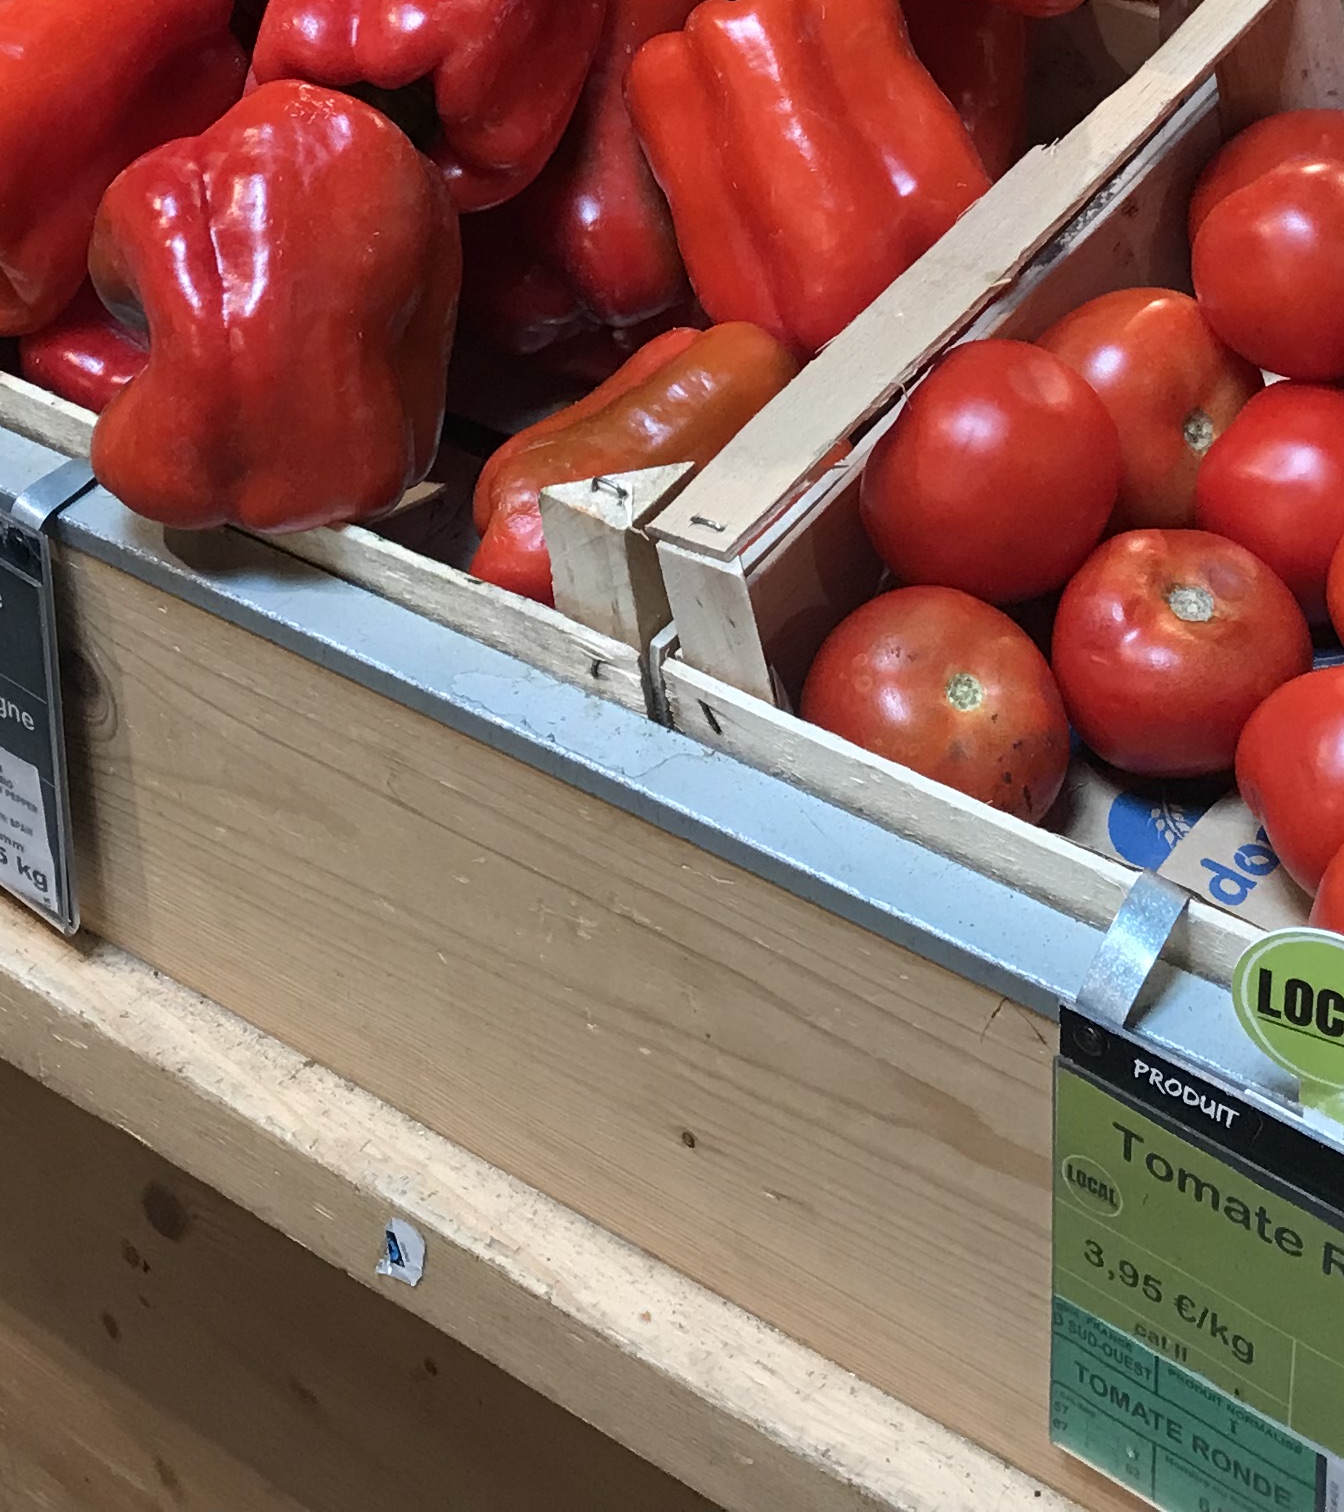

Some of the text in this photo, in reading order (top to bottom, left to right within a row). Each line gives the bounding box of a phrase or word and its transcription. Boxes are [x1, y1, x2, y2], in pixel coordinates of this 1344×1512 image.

[17, 856, 49, 893] kg
[1133, 1058, 1240, 1129] PRODUIT
[1066, 1163, 1119, 1209] LOCAL
[1112, 1121, 1304, 1259] Tomate
[1084, 1239, 1255, 1365] 3,95 €/kg
[1068, 1320, 1153, 1381] SUD-OUEST
[1135, 1323, 1188, 1362] cat II
[1074, 1360, 1184, 1444] TOMATE
[1191, 1434, 1294, 1507] RONDE
